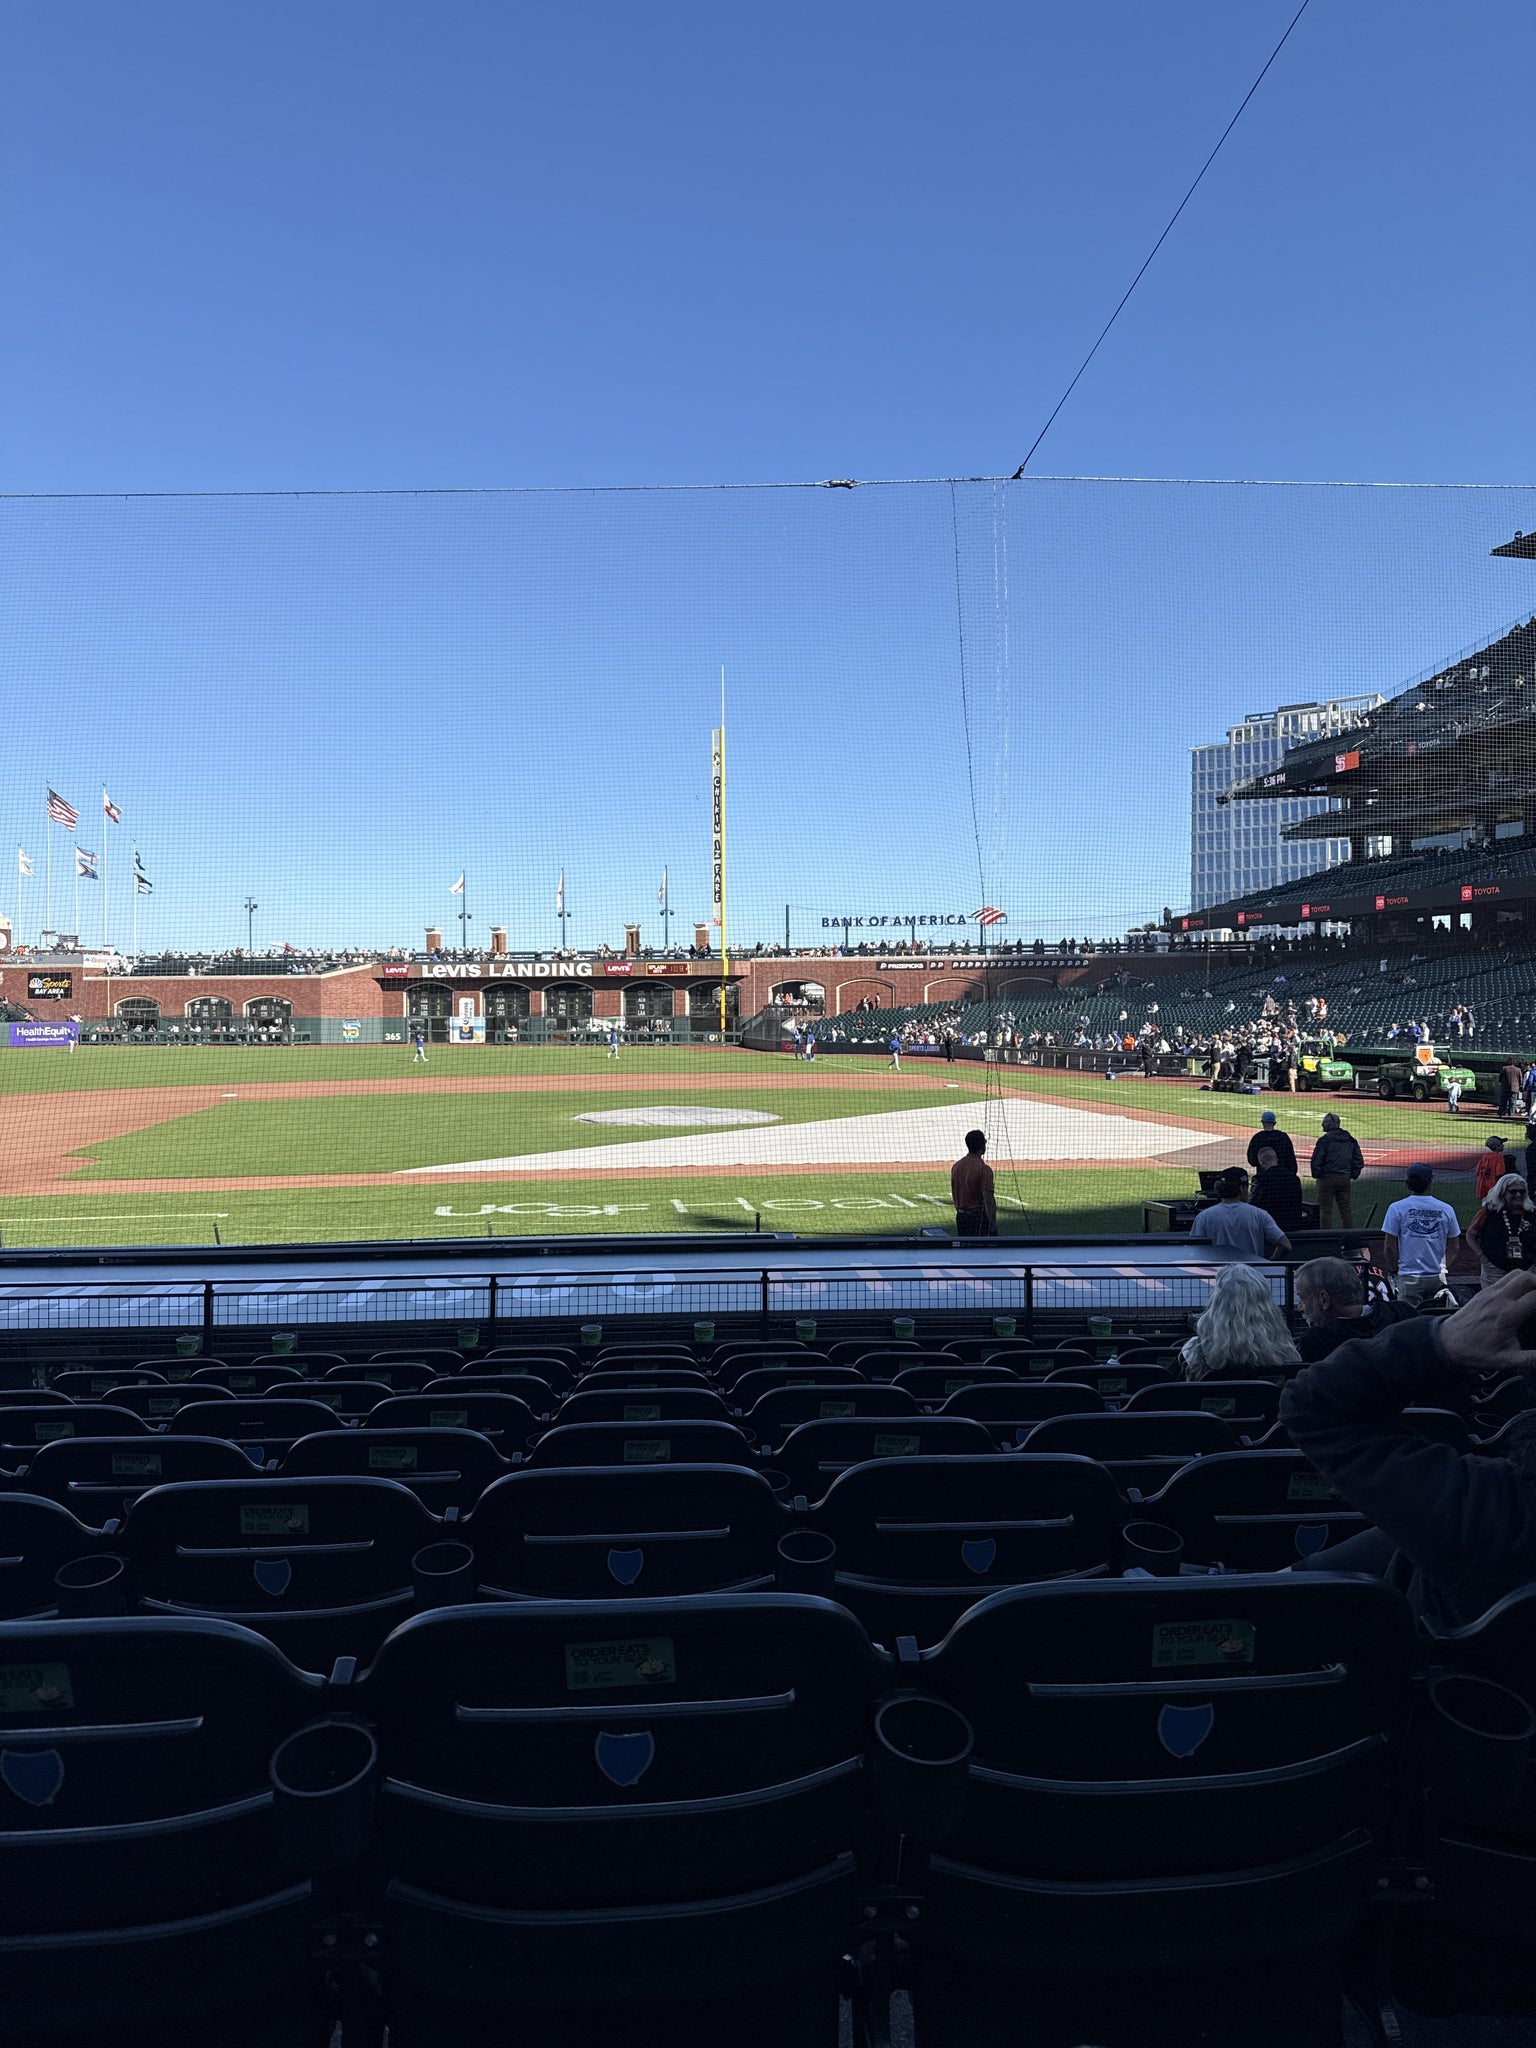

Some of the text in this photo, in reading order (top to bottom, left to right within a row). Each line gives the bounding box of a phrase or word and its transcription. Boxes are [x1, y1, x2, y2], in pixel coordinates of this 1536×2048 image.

[1473, 886, 1500, 896] TOYOTA
[1386, 896, 1409, 905] TOYOTA
[1310, 905, 1331, 913] TOYOTA
[822, 914, 967, 928] BANK OF AMERICA
[1245, 912, 1263, 920] TOYOTA
[489, 962, 593, 977] LANDING
[42, 977, 71, 989] Sports
[385, 1033, 401, 1041] 365
[434, 1202, 650, 1217] UCSF
[1159, 1623, 1233, 1637] ORDER EATS
[571, 1643, 651, 1658] ORDER EATS
